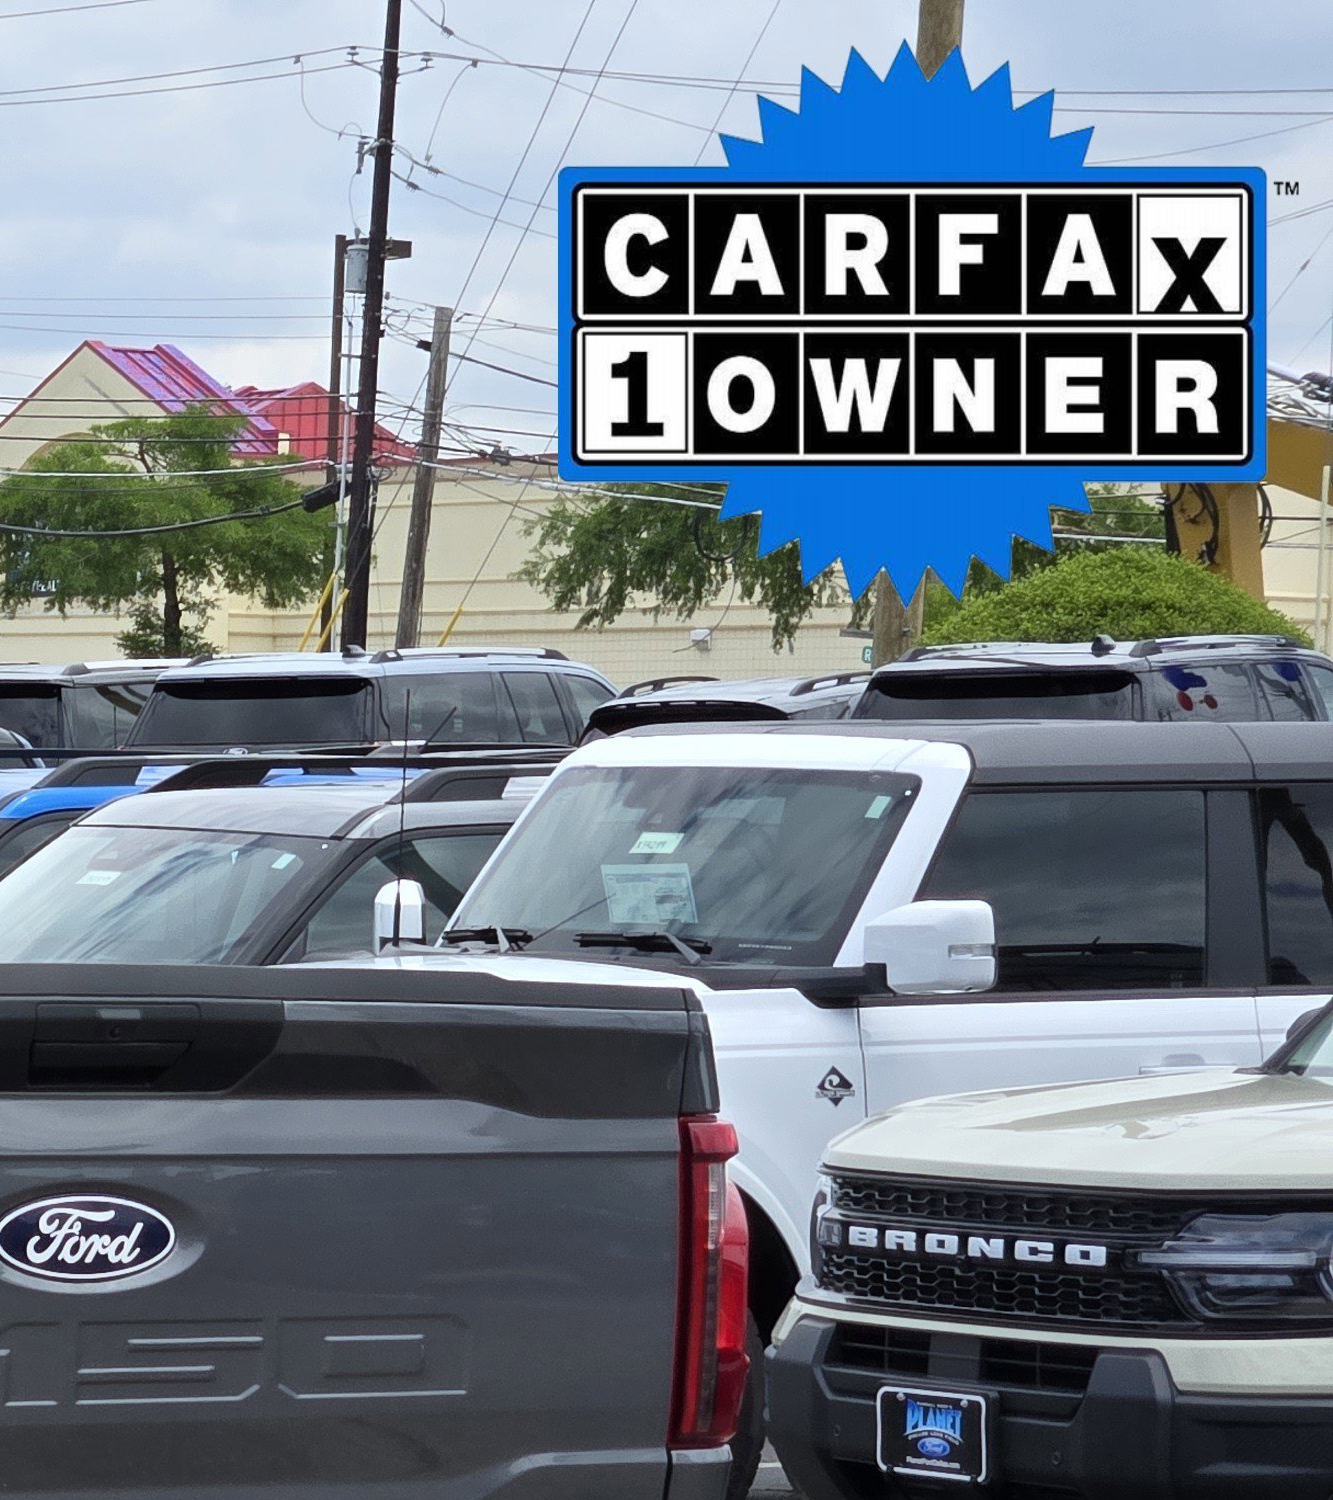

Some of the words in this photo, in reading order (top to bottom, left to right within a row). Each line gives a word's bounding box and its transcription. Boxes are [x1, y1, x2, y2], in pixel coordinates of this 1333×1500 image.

[26, 1207, 144, 1263] Ford
[848, 1225, 1108, 1267] BRONCO
[906, 1399, 963, 1439] PLANET
